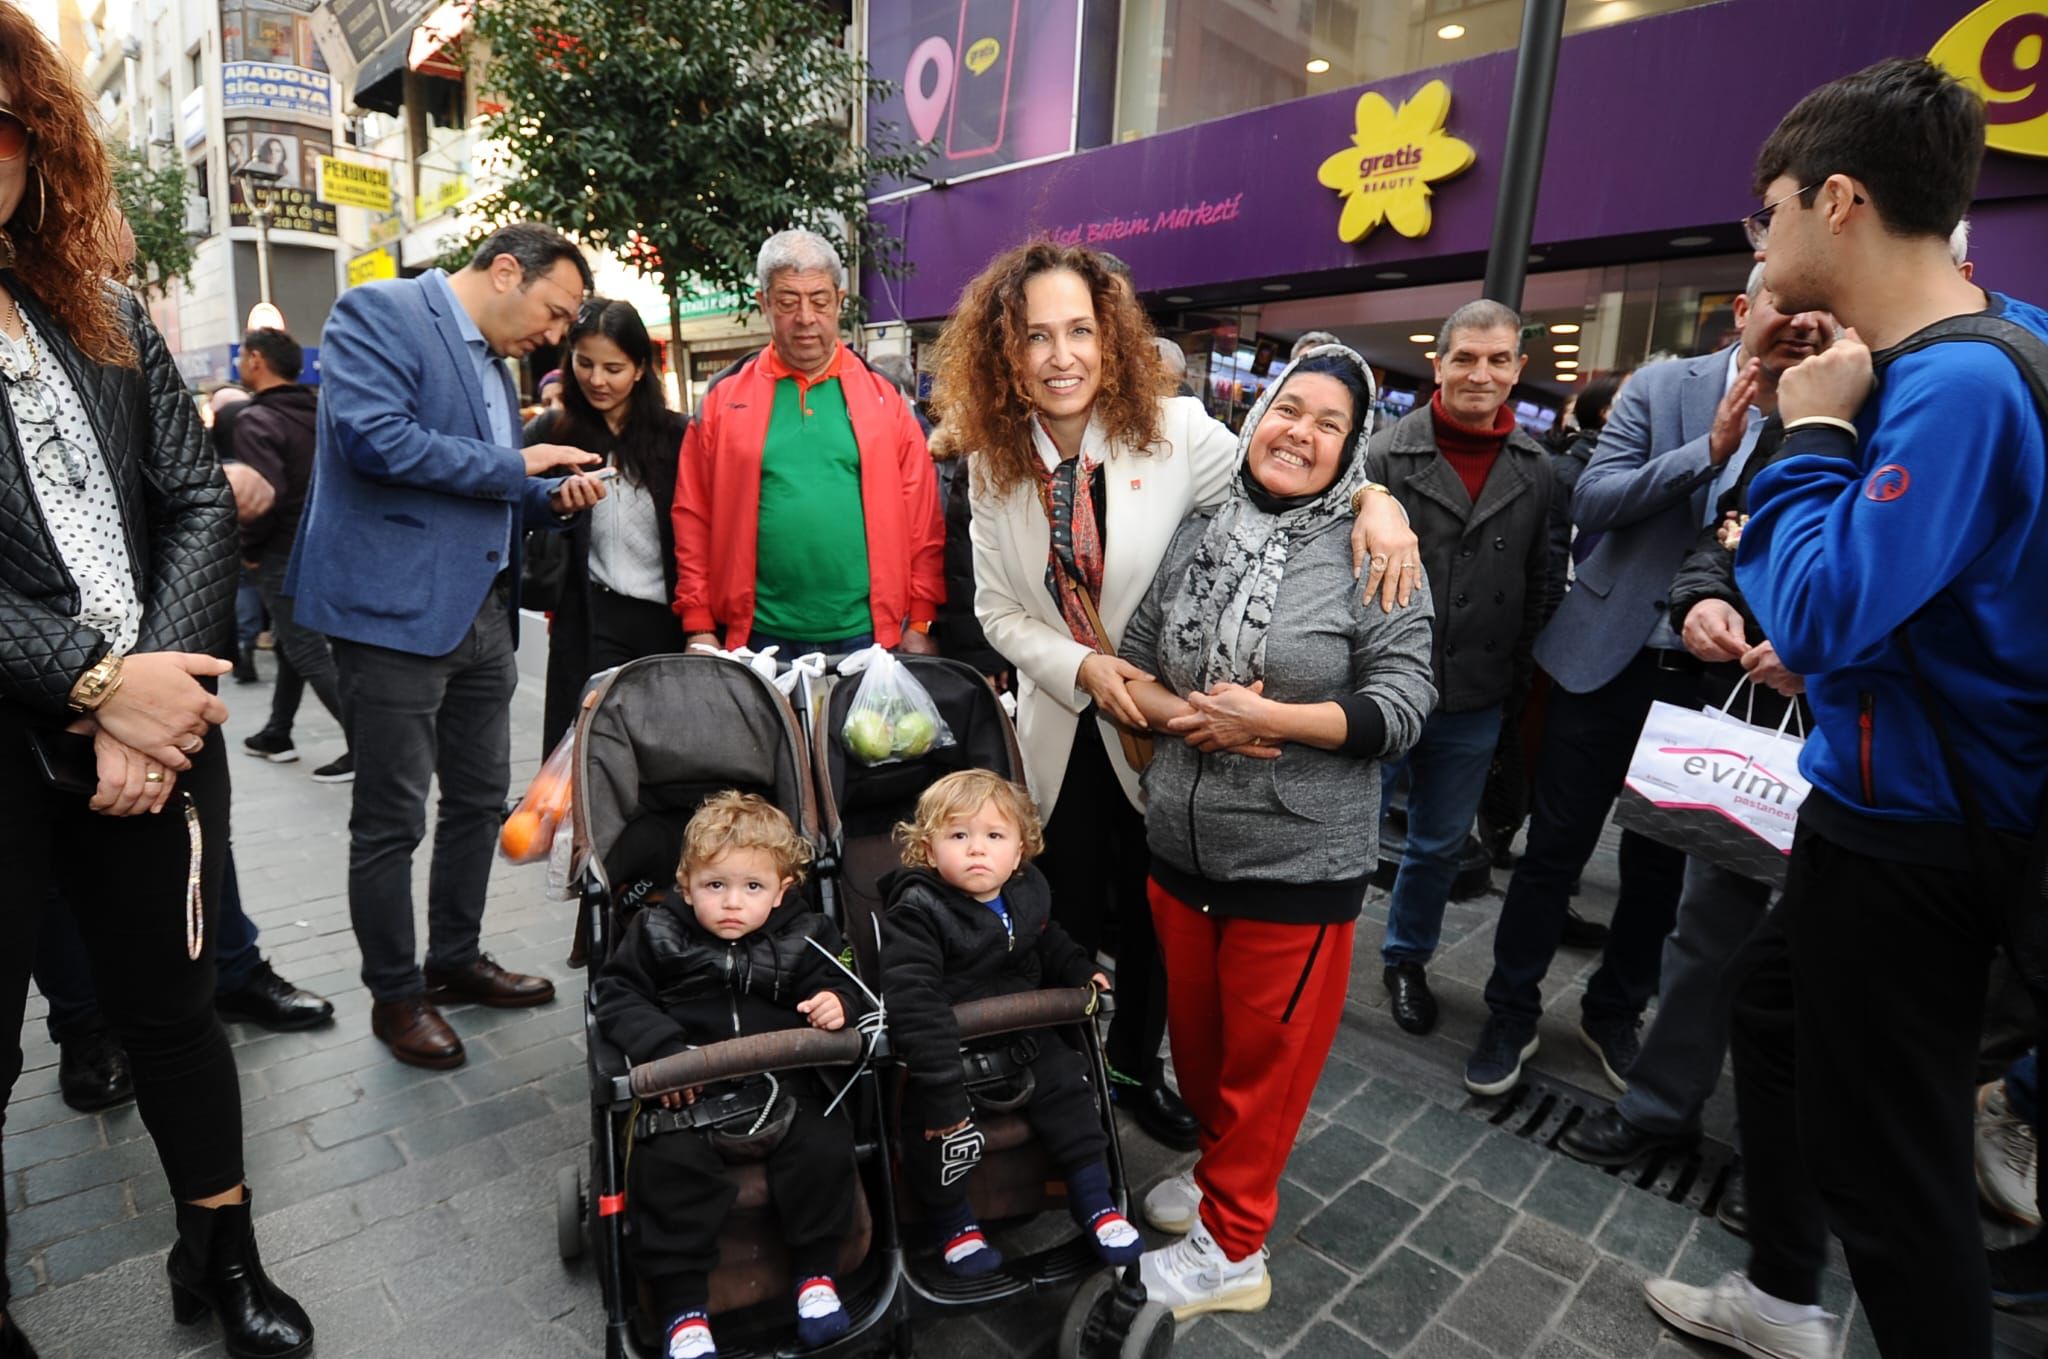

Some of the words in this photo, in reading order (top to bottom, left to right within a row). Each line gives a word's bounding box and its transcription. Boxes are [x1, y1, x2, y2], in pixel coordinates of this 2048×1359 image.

[225, 65, 329, 90] ANADOLU
[1360, 144, 1422, 178] gratis
[1363, 176, 1414, 193] BEAUTY
[1683, 755, 1788, 805] evim
[1733, 795, 1796, 822] pastanesi
